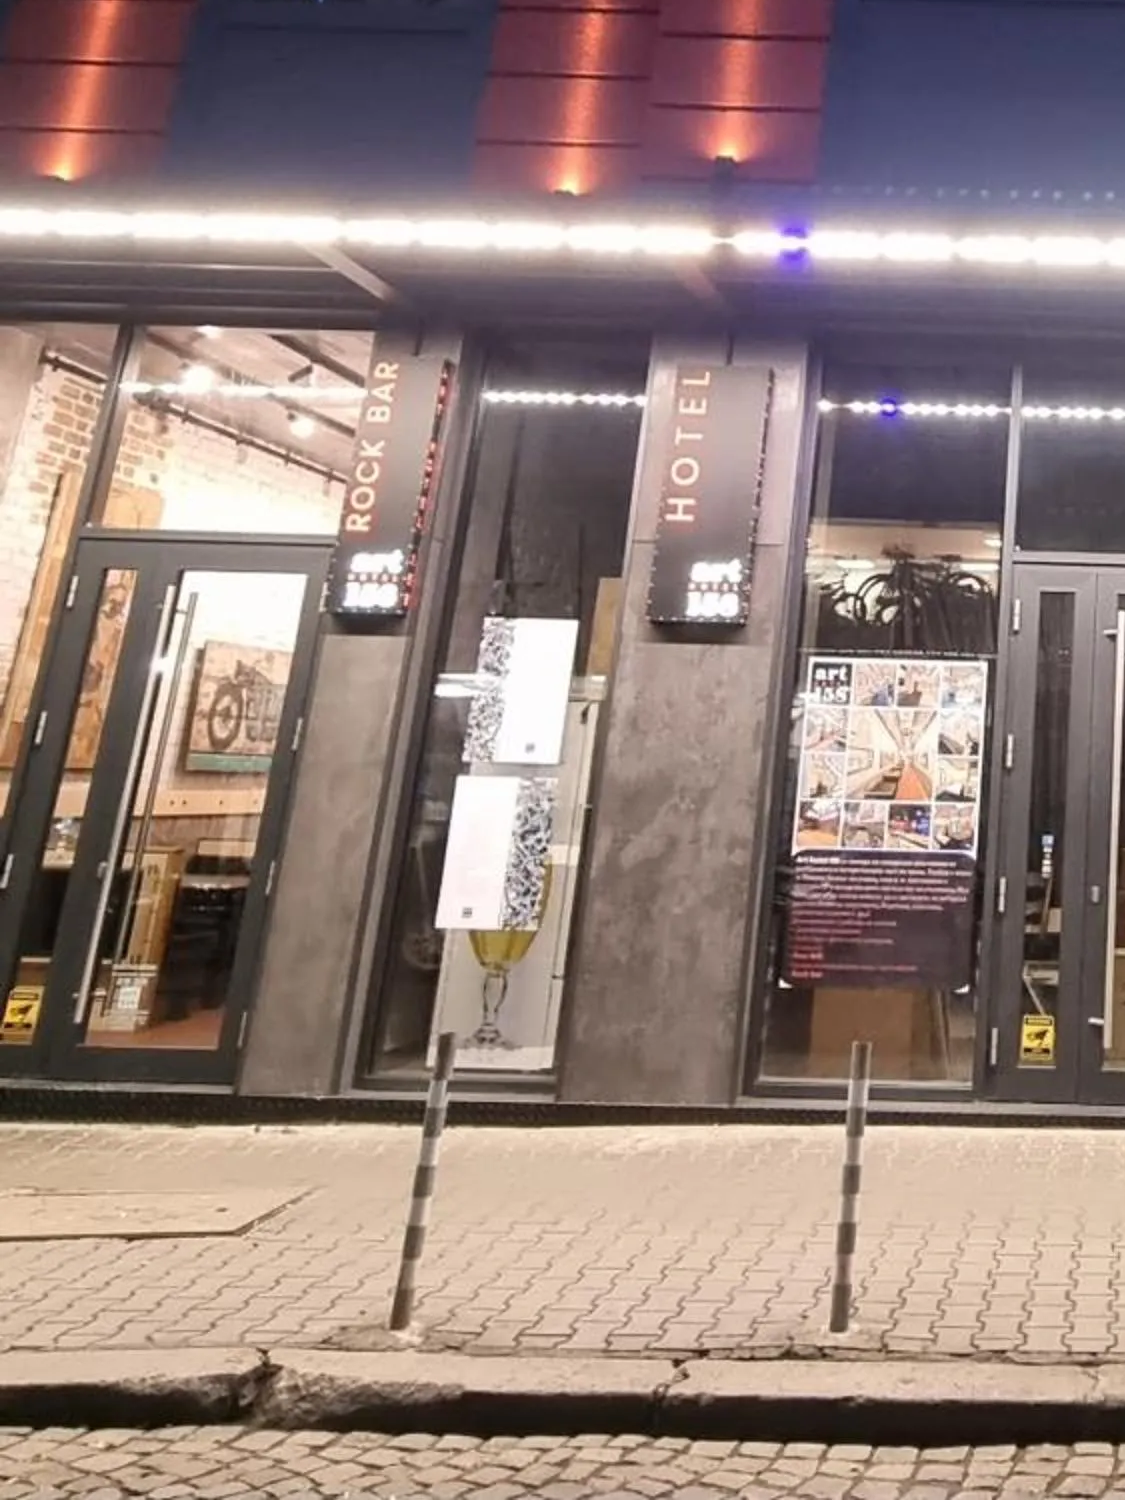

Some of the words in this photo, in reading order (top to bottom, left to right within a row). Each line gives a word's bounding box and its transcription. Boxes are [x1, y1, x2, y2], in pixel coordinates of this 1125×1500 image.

[345, 439, 385, 534] ROCK
[366, 361, 400, 423] BAR
[665, 370, 711, 523] HOTEL
[814, 665, 848, 681] art
